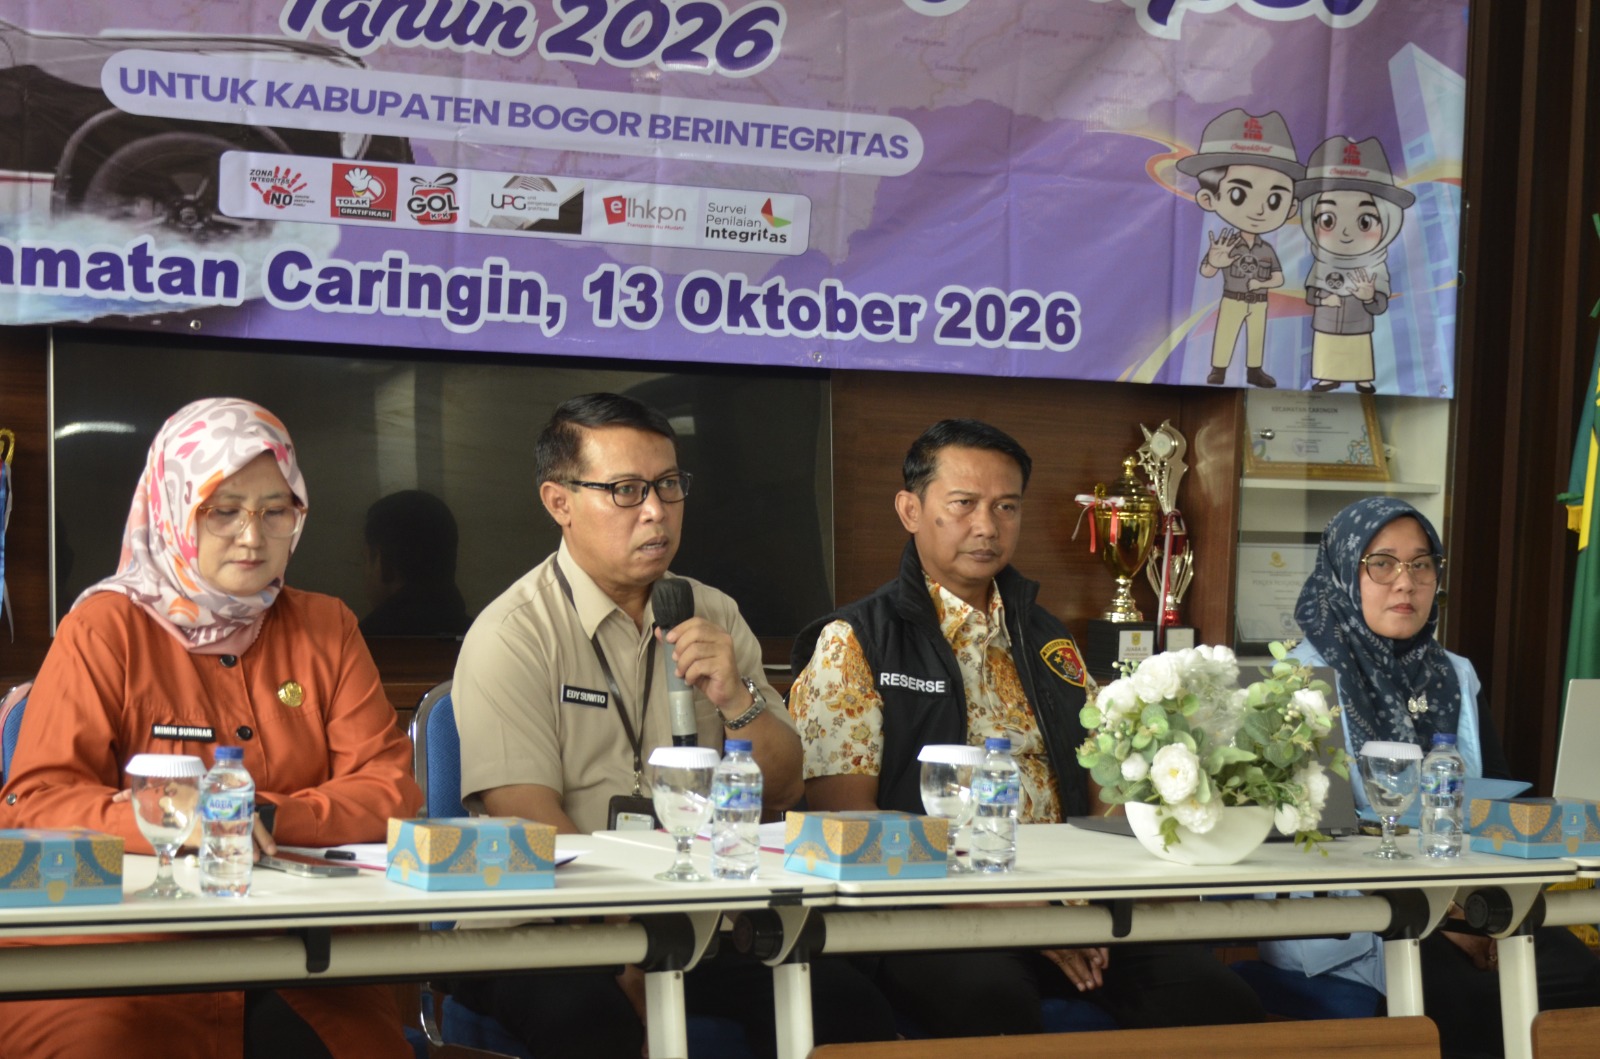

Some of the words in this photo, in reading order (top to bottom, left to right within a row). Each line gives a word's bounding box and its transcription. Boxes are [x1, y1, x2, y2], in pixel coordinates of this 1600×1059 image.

[545, 0, 780, 72] 2026
[119, 66, 256, 106] UNTUK
[264, 80, 500, 127] KABUPATEN
[507, 101, 642, 138] BOGOR
[648, 113, 910, 160] BERINTEGRITAS
[249, 169, 273, 177] ZONA
[249, 176, 291, 186] INTEGRITAS
[270, 193, 293, 207] NO
[337, 198, 369, 206] TOLAK
[407, 193, 460, 215] GOL
[491, 193, 527, 211] UPG
[340, 207, 390, 218] GRATIFIKASI
[708, 202, 747, 215] Survei
[706, 214, 762, 228] Penilaian
[705, 226, 788, 244] Integritas
[267, 249, 560, 330] Caringin,
[589, 270, 658, 324] 13
[680, 275, 921, 337] Oktober
[938, 291, 1077, 345] 2026
[880, 672, 946, 693] RESERSE
[566, 689, 580, 700] EDY
[580, 691, 606, 704] SUWITO
[154, 725, 178, 736] MIMIN
[178, 726, 213, 738] SUMINAR
